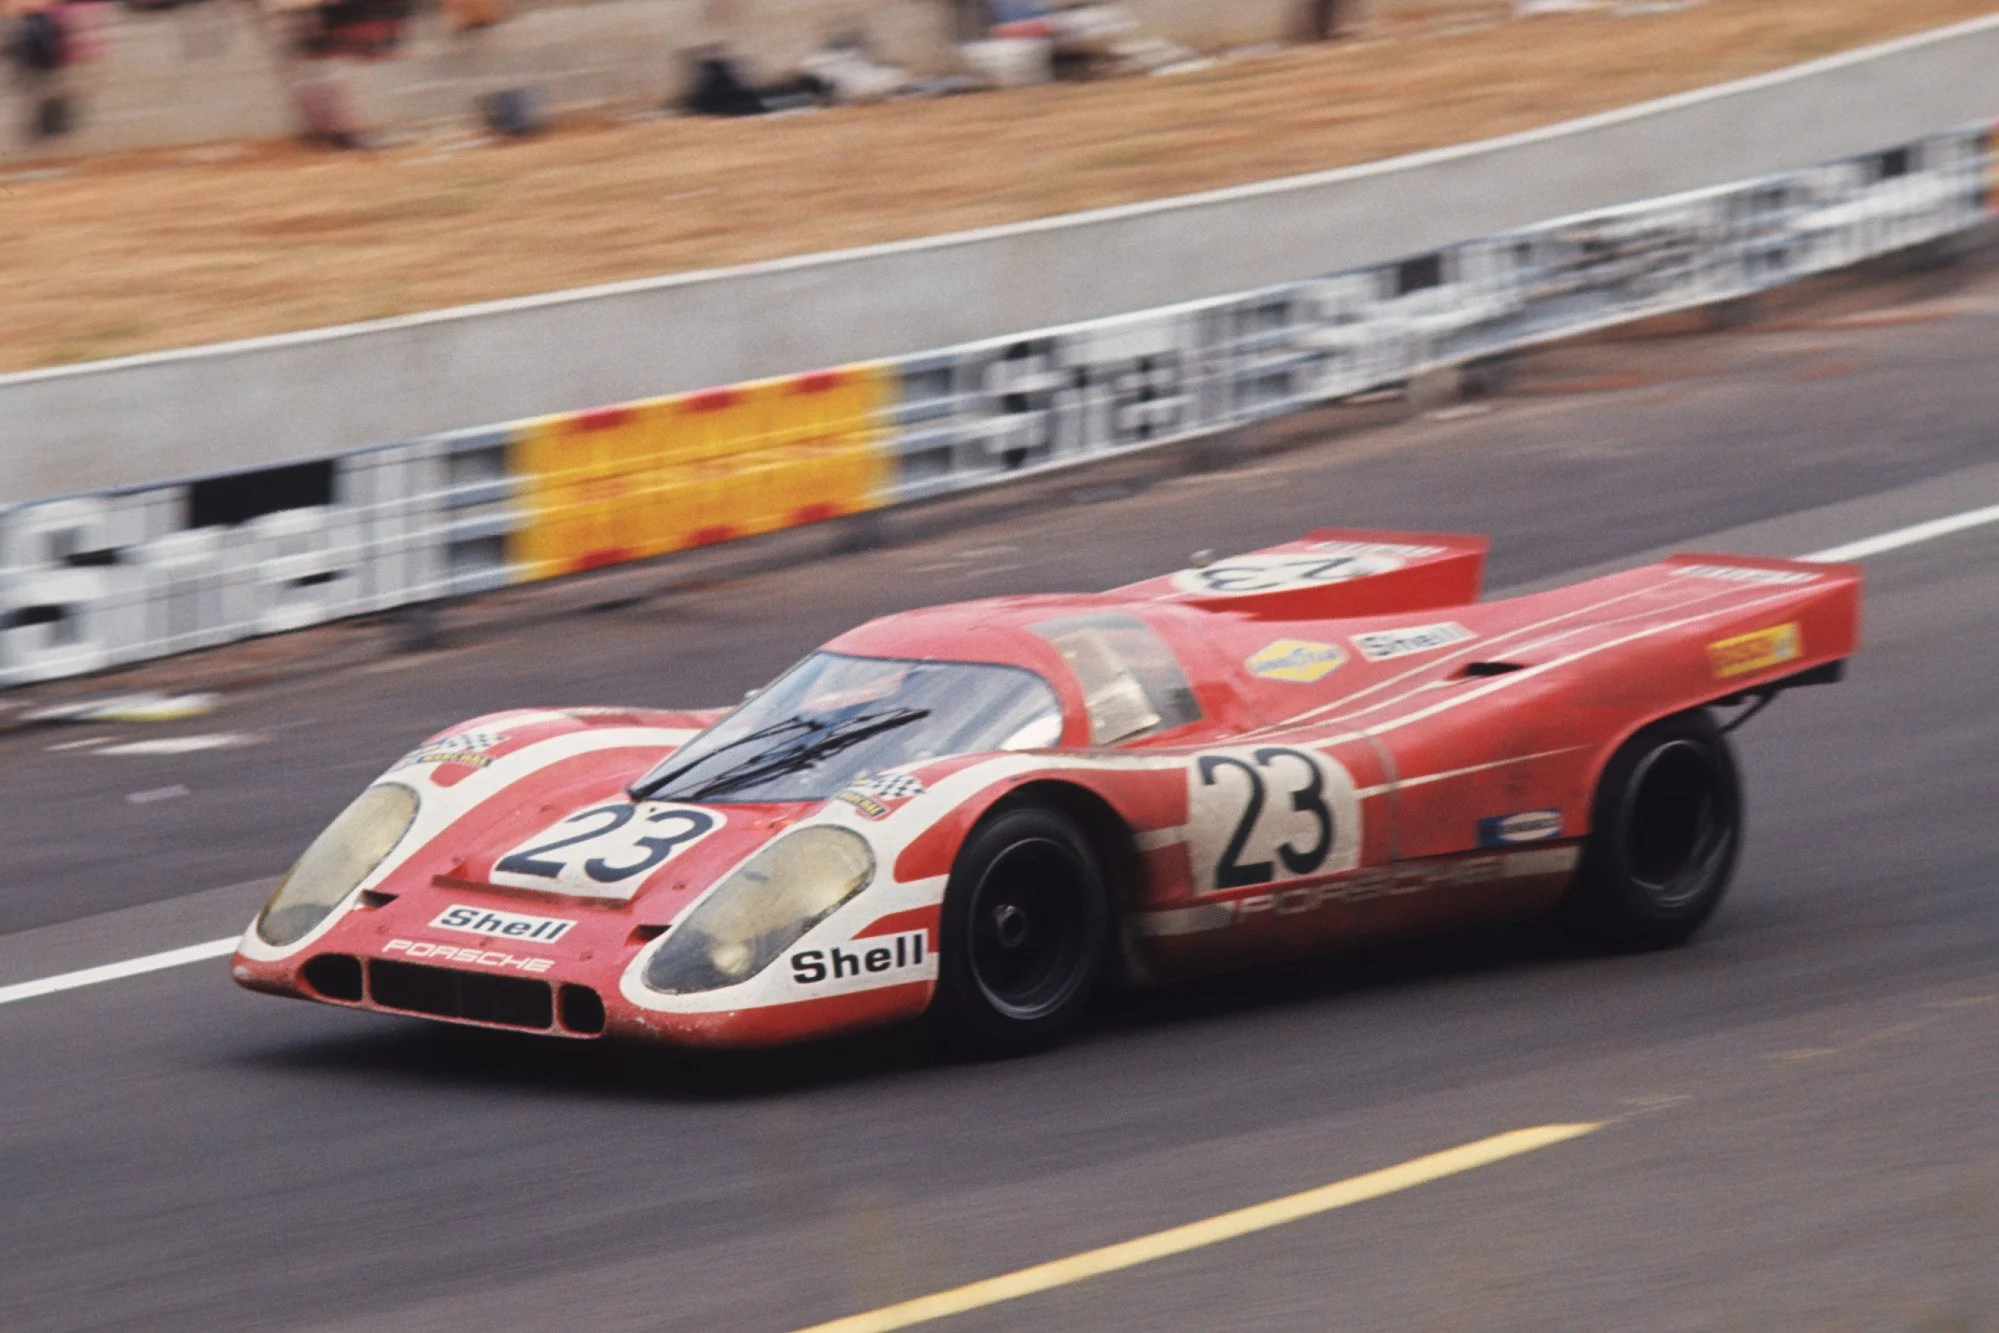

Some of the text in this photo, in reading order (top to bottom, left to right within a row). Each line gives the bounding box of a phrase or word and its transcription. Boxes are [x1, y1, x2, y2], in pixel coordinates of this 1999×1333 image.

[495, 803, 714, 884] 23
[1197, 747, 1333, 889] 23
[441, 908, 567, 940] Shell
[381, 938, 556, 974] PORSCHE
[791, 933, 922, 984] Shell
